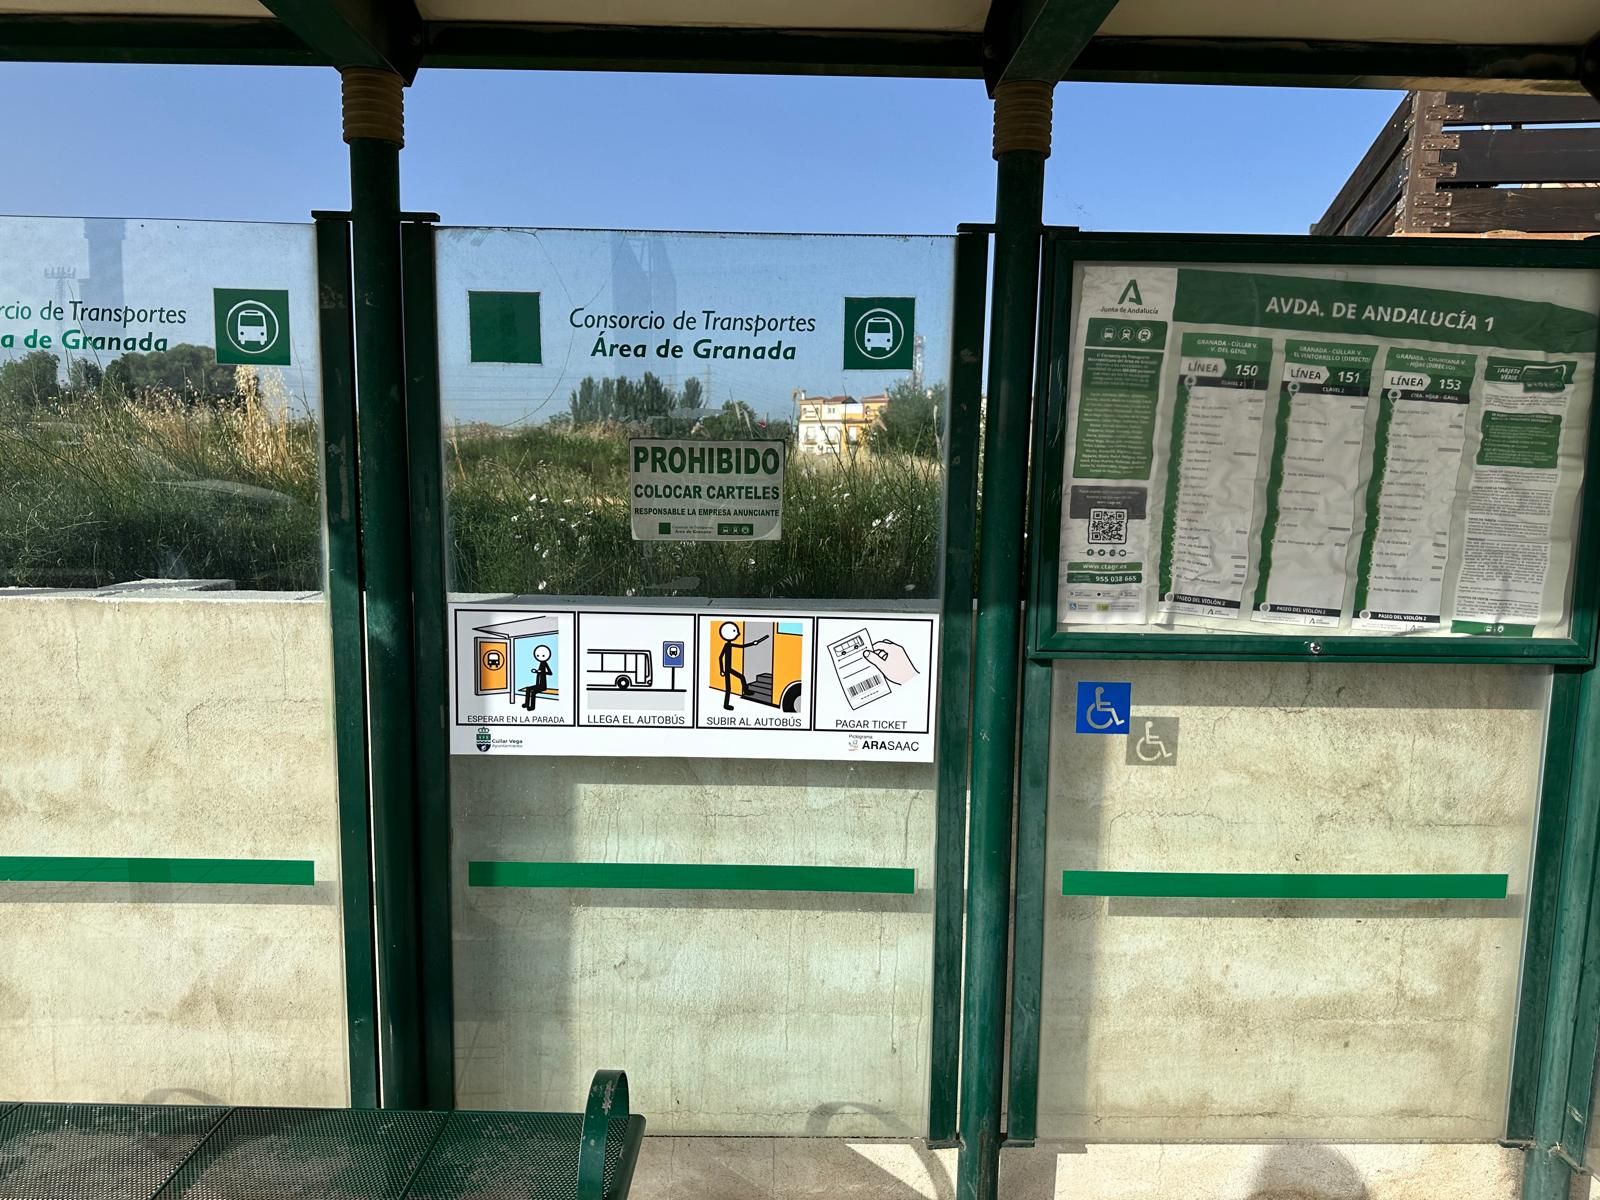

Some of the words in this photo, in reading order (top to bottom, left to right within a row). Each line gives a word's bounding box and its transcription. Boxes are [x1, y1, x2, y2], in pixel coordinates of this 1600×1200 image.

[40, 300, 64, 321] de
[69, 300, 187, 328] Transportes
[569, 307, 665, 329] Consorcio
[673, 310, 697, 330] de
[702, 310, 816, 337] Transportes
[1266, 296, 1325, 317] AVDA.
[1332, 302, 1357, 319] DE
[1362, 304, 1477, 331] ANDALUCÍA
[1485, 316, 1495, 332] 1
[24, 329, 52, 349] de
[62, 329, 168, 351] Granada
[591, 331, 647, 358] Área
[656, 339, 684, 358] de
[693, 338, 796, 360] Granada
[1188, 360, 1219, 373] LÍNEA
[1235, 364, 1259, 376] 150
[1290, 367, 1321, 380] LÍNEA
[1337, 371, 1360, 383] 151
[1390, 375, 1424, 387] LÍNEA
[1439, 378, 1462, 391] 153
[633, 446, 780, 475] PROHIBIDO
[634, 484, 702, 499] COLOCAR
[706, 485, 780, 500] CARTELES
[634, 507, 686, 516] RESPONSABLE
[687, 508, 696, 516] LA
[698, 508, 732, 516] EMPRESA
[733, 509, 780, 517] ANUNCIANTE
[1095, 575, 1109, 583] 955
[1110, 575, 1123, 583] 038
[467, 714, 505, 723] ESPERAR
[506, 715, 517, 723] EN
[520, 715, 530, 723] LA
[532, 715, 565, 724] PARADA
[587, 714, 620, 724] LLEGA
[623, 715, 634, 725] EL
[637, 713, 685, 725] AUTOBÚS
[706, 716, 737, 726] SUBIR
[739, 716, 751, 727] AL
[754, 716, 802, 728] AUTOBÚS
[835, 719, 870, 729] PAGAR
[872, 720, 908, 730] TICKET
[862, 740, 919, 752] ARASAAC
